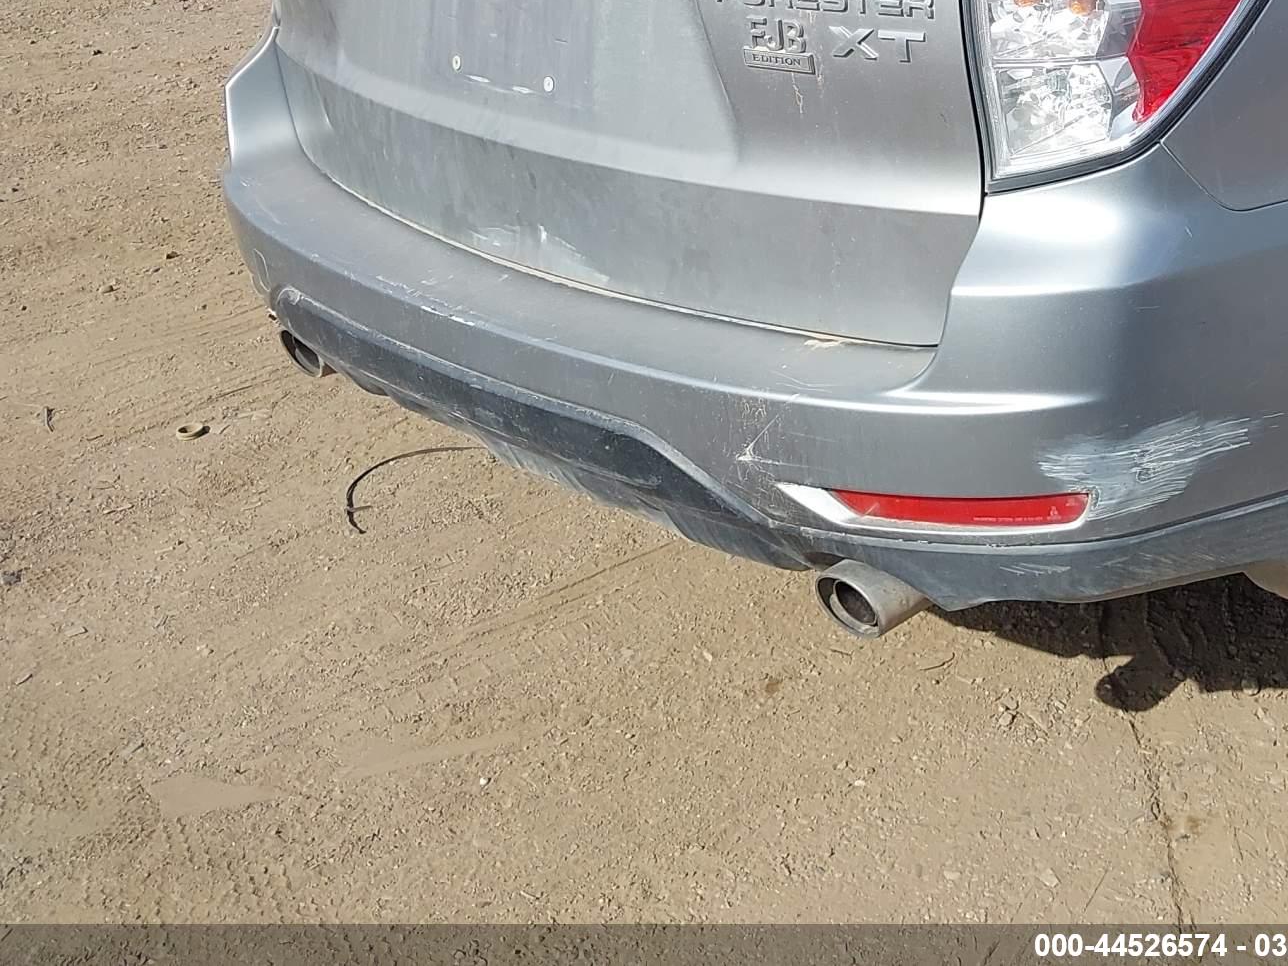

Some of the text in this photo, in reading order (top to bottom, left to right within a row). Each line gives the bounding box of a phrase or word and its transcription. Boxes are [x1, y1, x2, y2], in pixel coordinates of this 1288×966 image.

[747, 16, 806, 53] FJB
[829, 25, 926, 63] XT
[752, 53, 801, 66] EDITION
